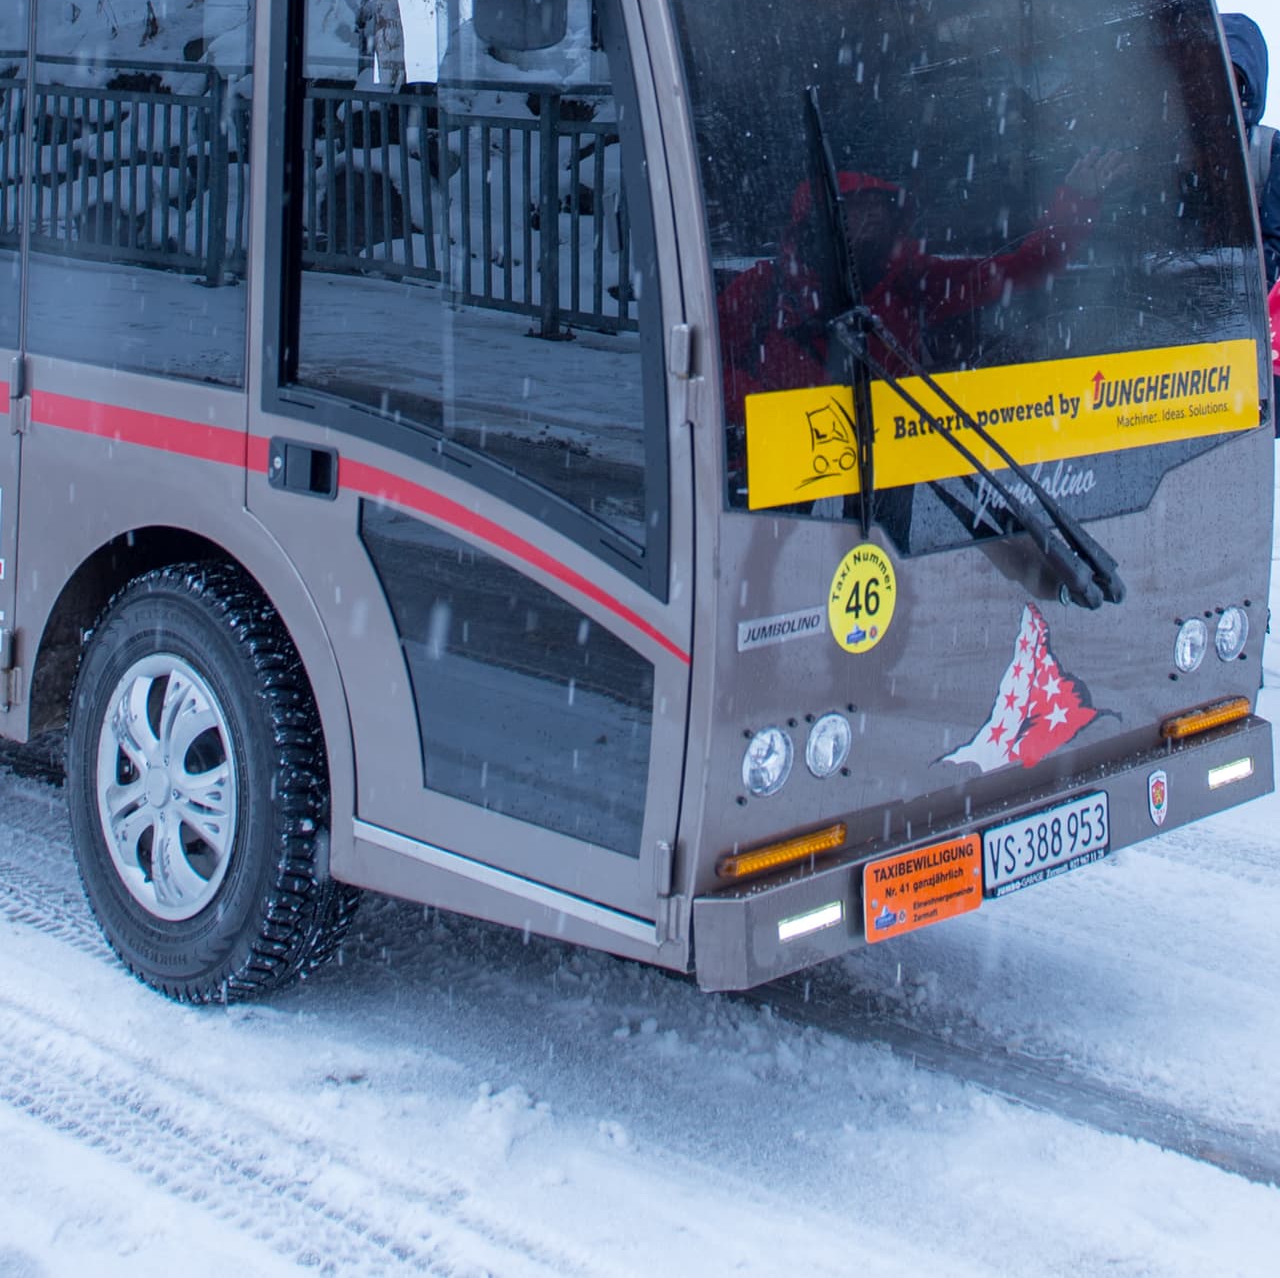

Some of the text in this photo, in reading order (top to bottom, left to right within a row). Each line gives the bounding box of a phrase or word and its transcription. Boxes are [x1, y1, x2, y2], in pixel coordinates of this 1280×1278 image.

[976, 394, 1055, 427] powered
[1058, 393, 1081, 419] by
[1092, 365, 1231, 411] JUNGHEINRICH
[832, 550, 892, 603] Taxi Nummer
[844, 577, 880, 619] 46
[743, 614, 821, 644] JUMBOLINO
[873, 843, 974, 883] TAXIBEWILLIGUNG
[885, 887, 897, 899] Nr.
[900, 883, 910, 894] 41
